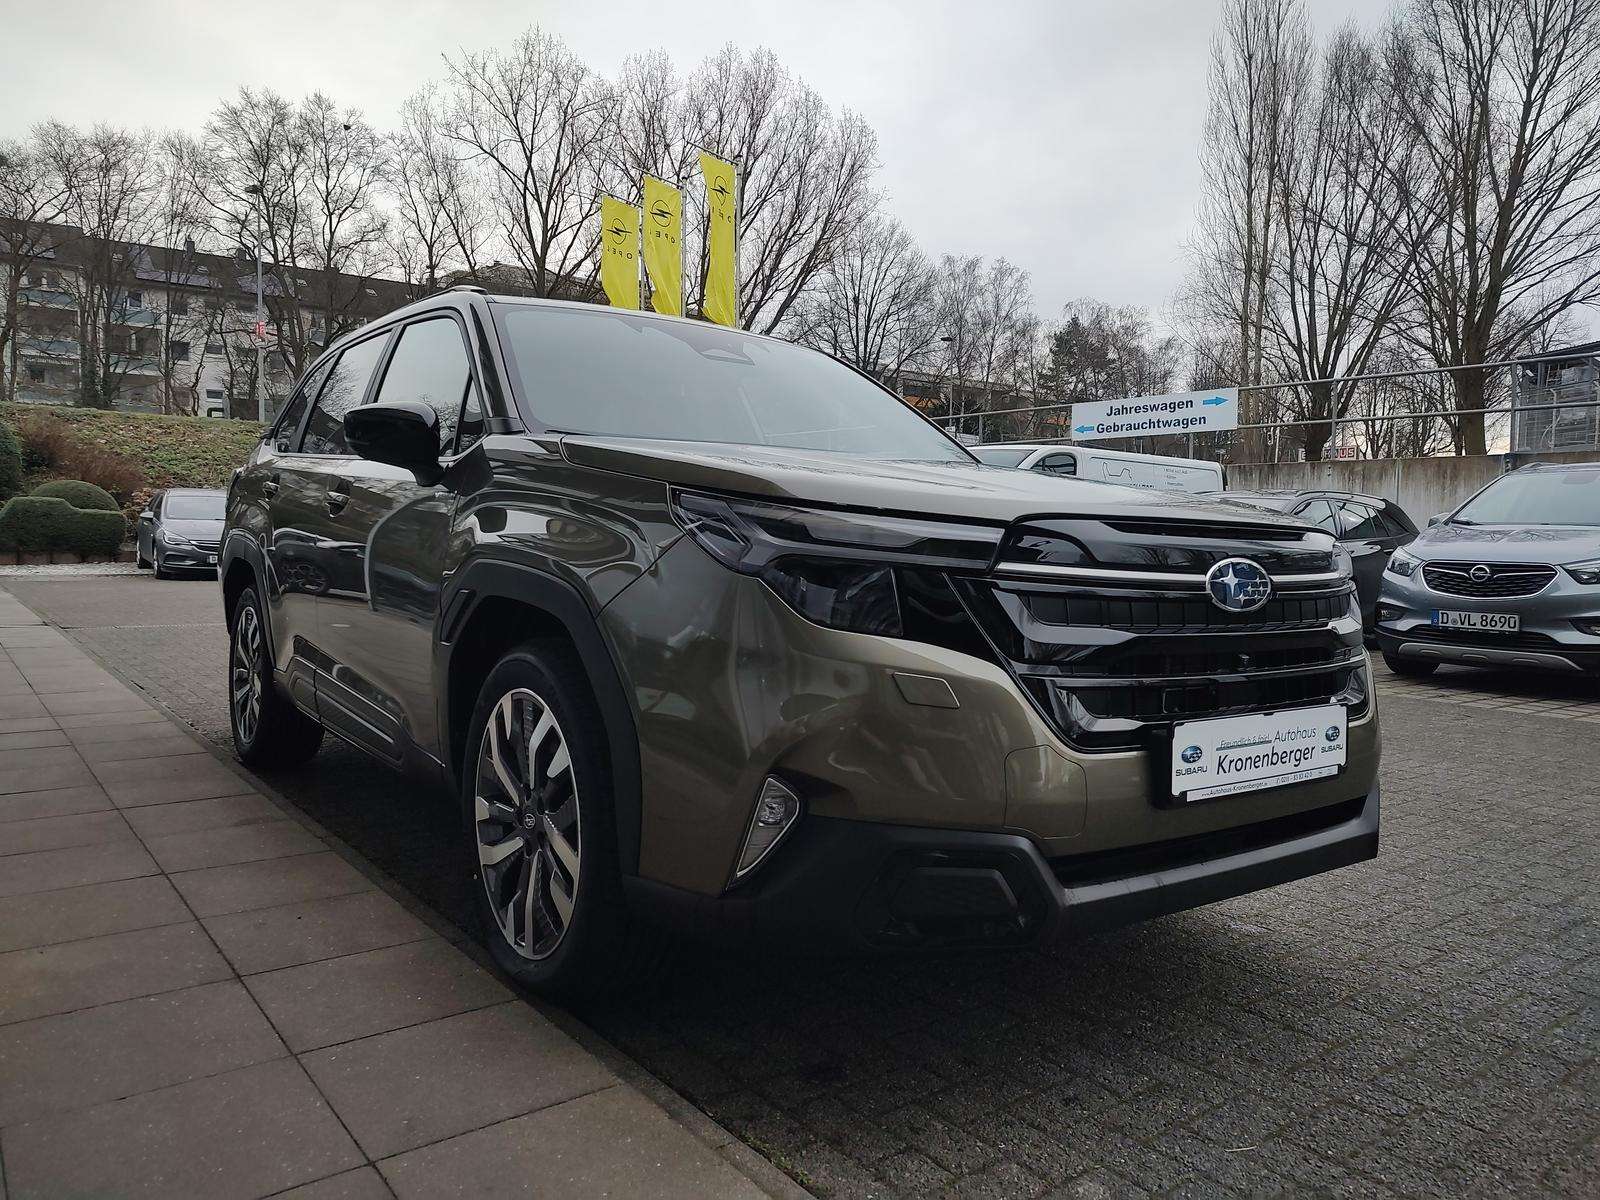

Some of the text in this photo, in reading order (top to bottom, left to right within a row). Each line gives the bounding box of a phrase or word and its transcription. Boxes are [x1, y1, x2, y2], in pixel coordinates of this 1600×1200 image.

[1106, 399, 1194, 417] Jahreswagen
[1096, 415, 1207, 434] Gebrauchtwagen
[1440, 612, 1517, 629] D VL 8690
[1273, 725, 1317, 743] Autohaus
[1320, 743, 1343, 754] SUBARU
[1216, 745, 1316, 775] Kronenberger
[1175, 765, 1208, 777] SUBARU
